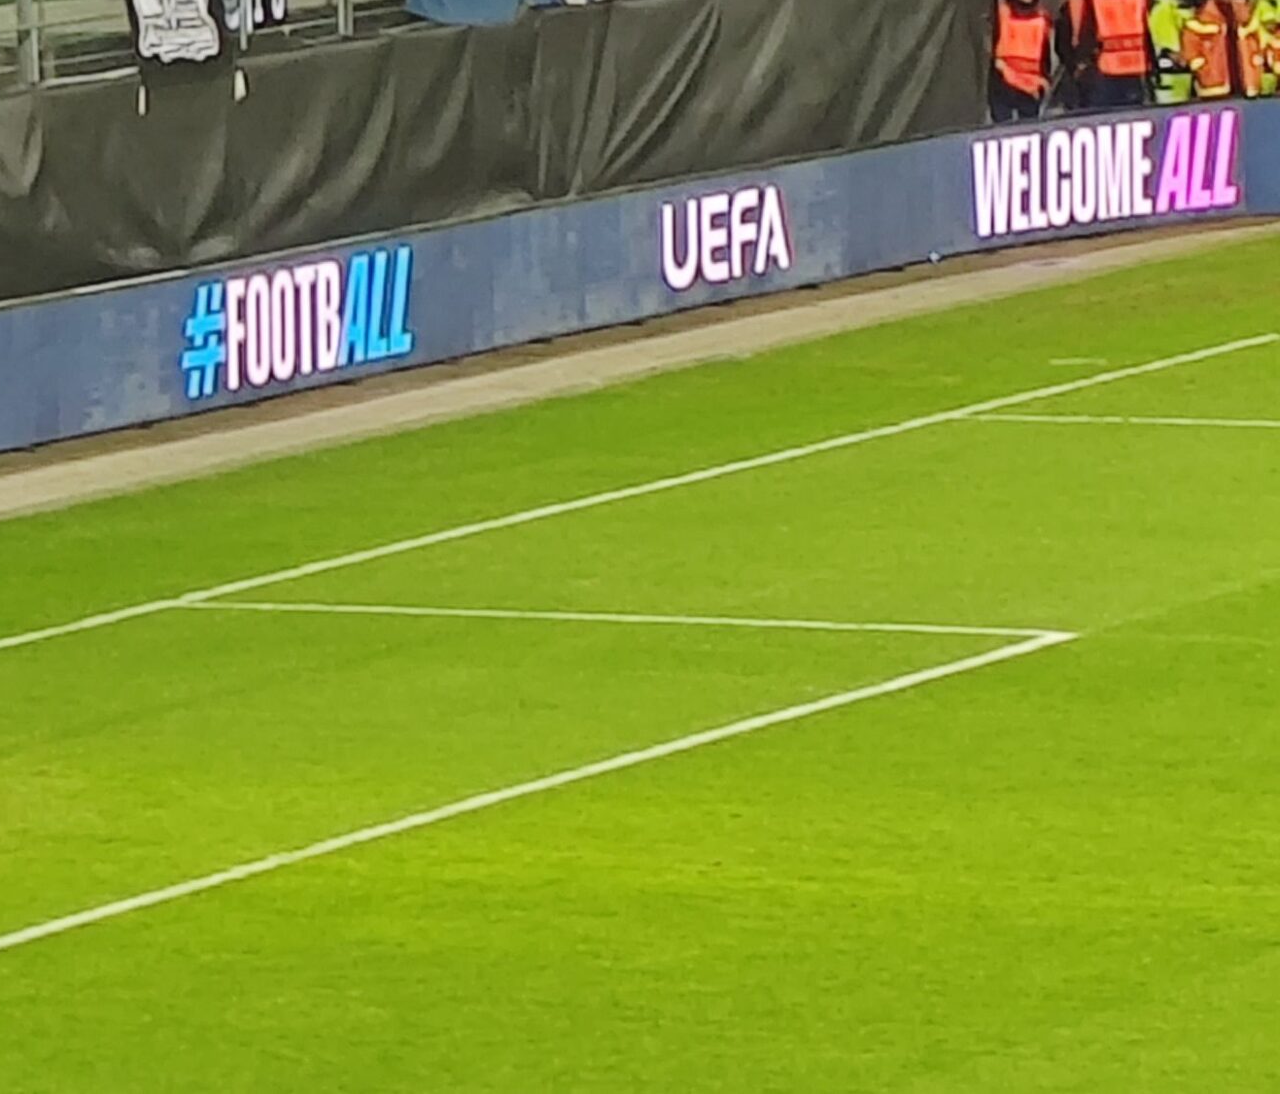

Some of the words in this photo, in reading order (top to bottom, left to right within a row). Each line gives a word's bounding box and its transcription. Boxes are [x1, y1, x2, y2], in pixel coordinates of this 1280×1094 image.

[662, 185, 790, 289] UEFA
[973, 121, 1153, 237] WELCOME
[1155, 110, 1238, 213] ALL
[182, 246, 413, 398] #FOOTBALL
